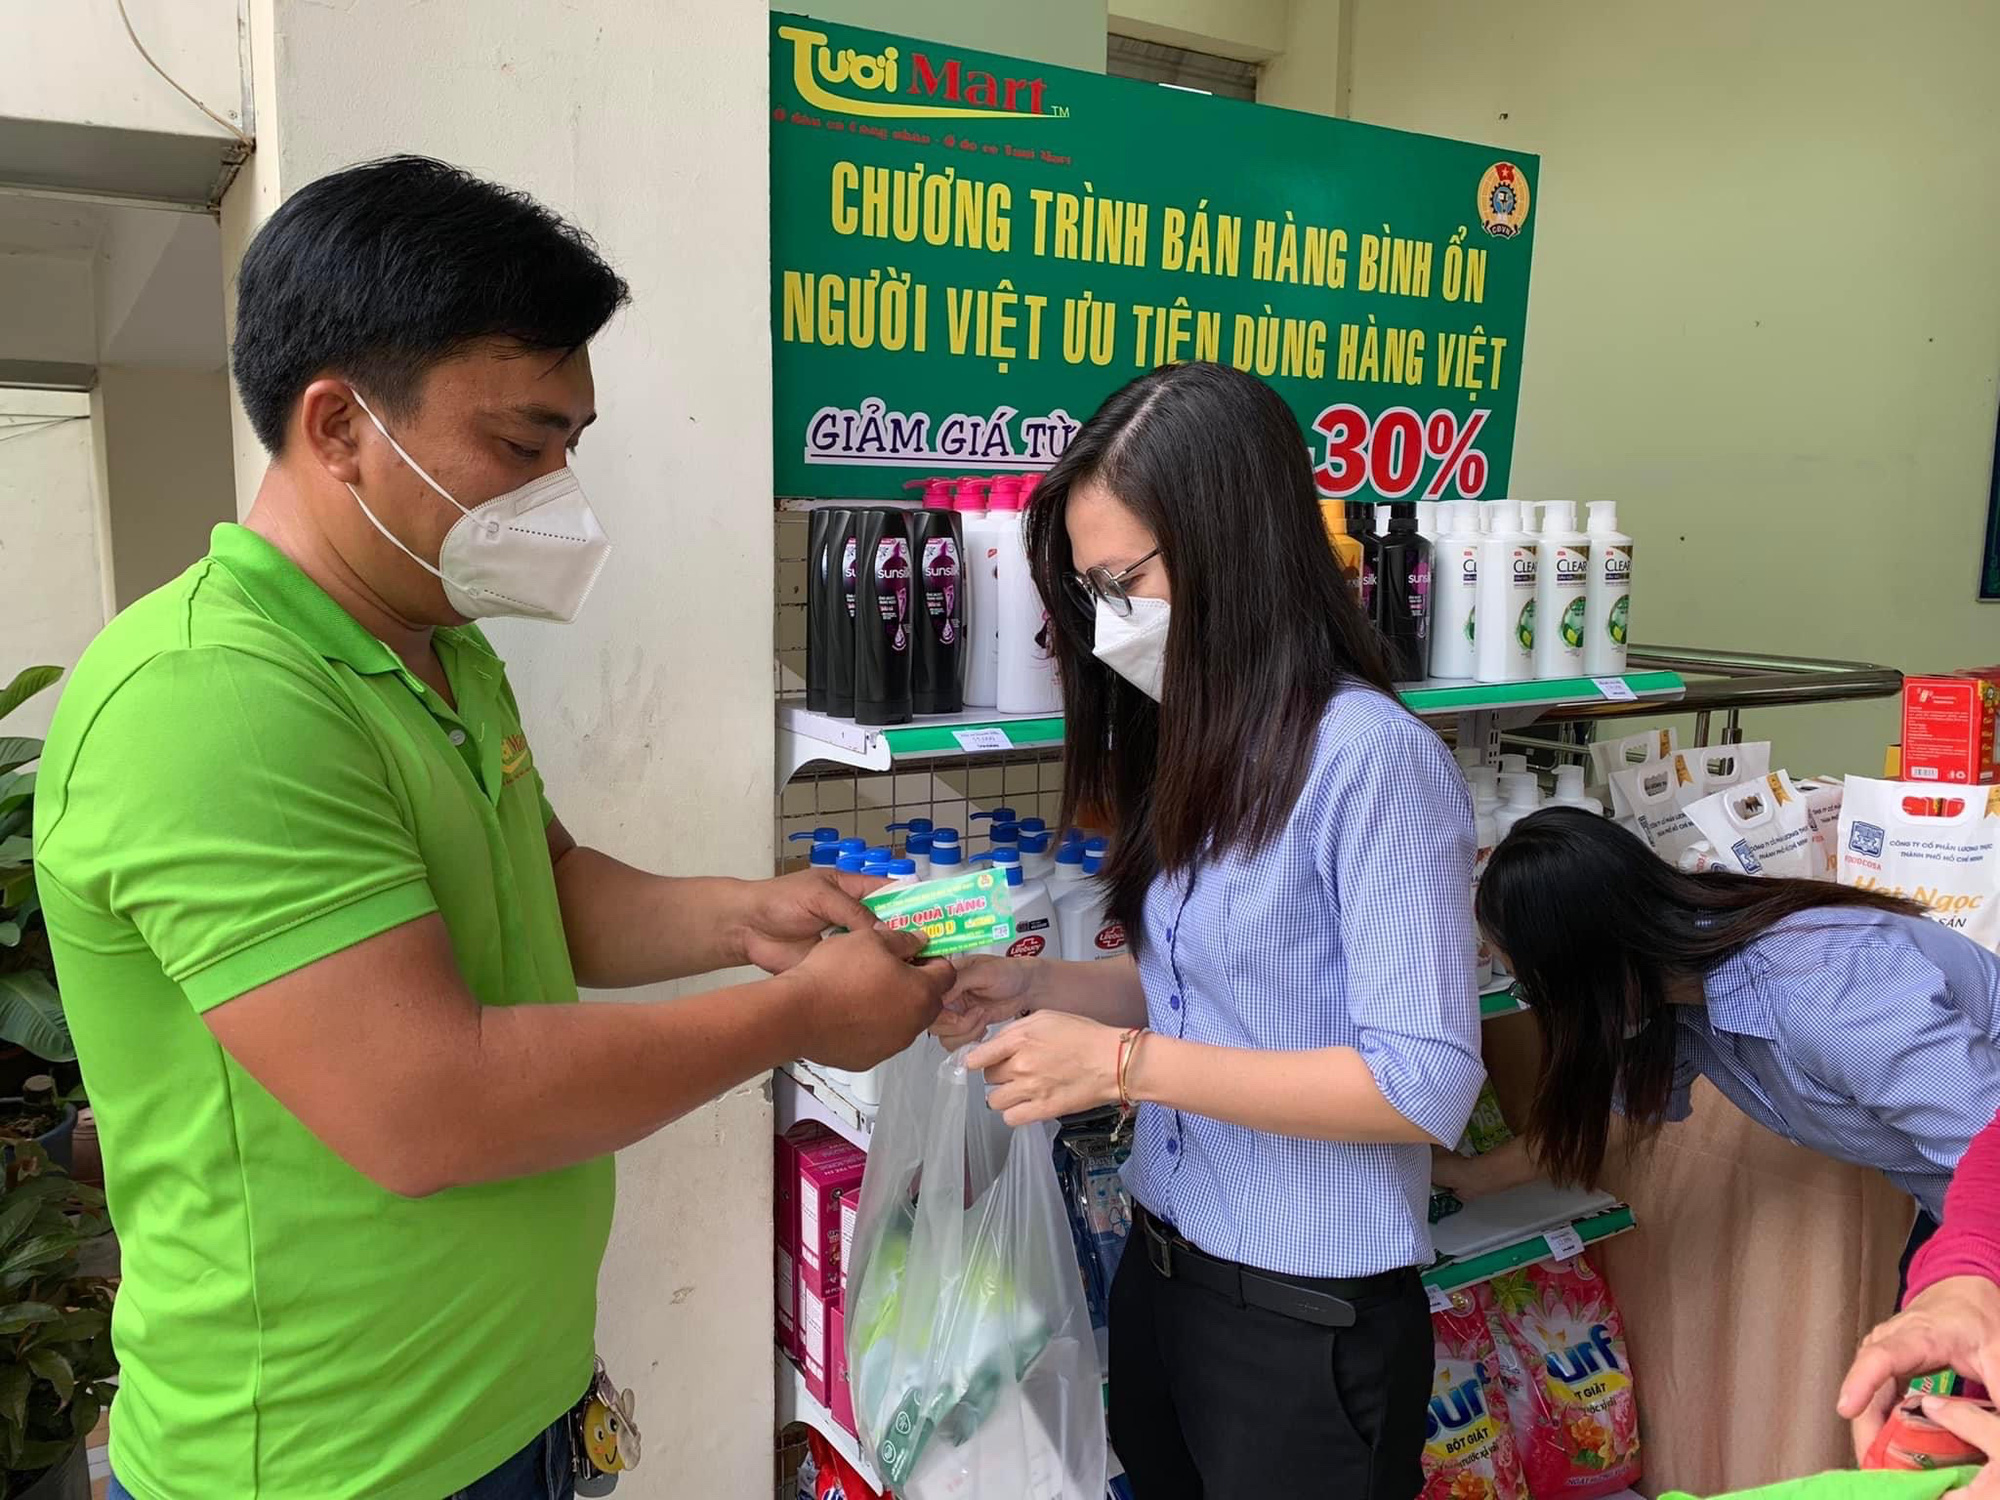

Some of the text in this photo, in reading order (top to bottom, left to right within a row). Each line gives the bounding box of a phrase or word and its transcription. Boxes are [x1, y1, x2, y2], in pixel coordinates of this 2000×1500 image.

[778, 26, 1070, 117] Tươi Mart TM
[831, 161, 1487, 304] CHƯƠNG TRÌNH BÁN HÀNG BÌNH ỔN
[783, 266, 1508, 402] NGƯỜI VIỆT ƯU TIÊN DÙNG HÀNG VIỆT
[810, 402, 1492, 500] GIẢM GIÁ TỪ 30%
[1557, 559, 1587, 572] CLEAR
[912, 904, 943, 925] QUÀ
[1913, 885, 1984, 913] Ngọc
[1547, 1324, 1619, 1383] urf
[1446, 1427, 1489, 1453] BỘT GIẶT
